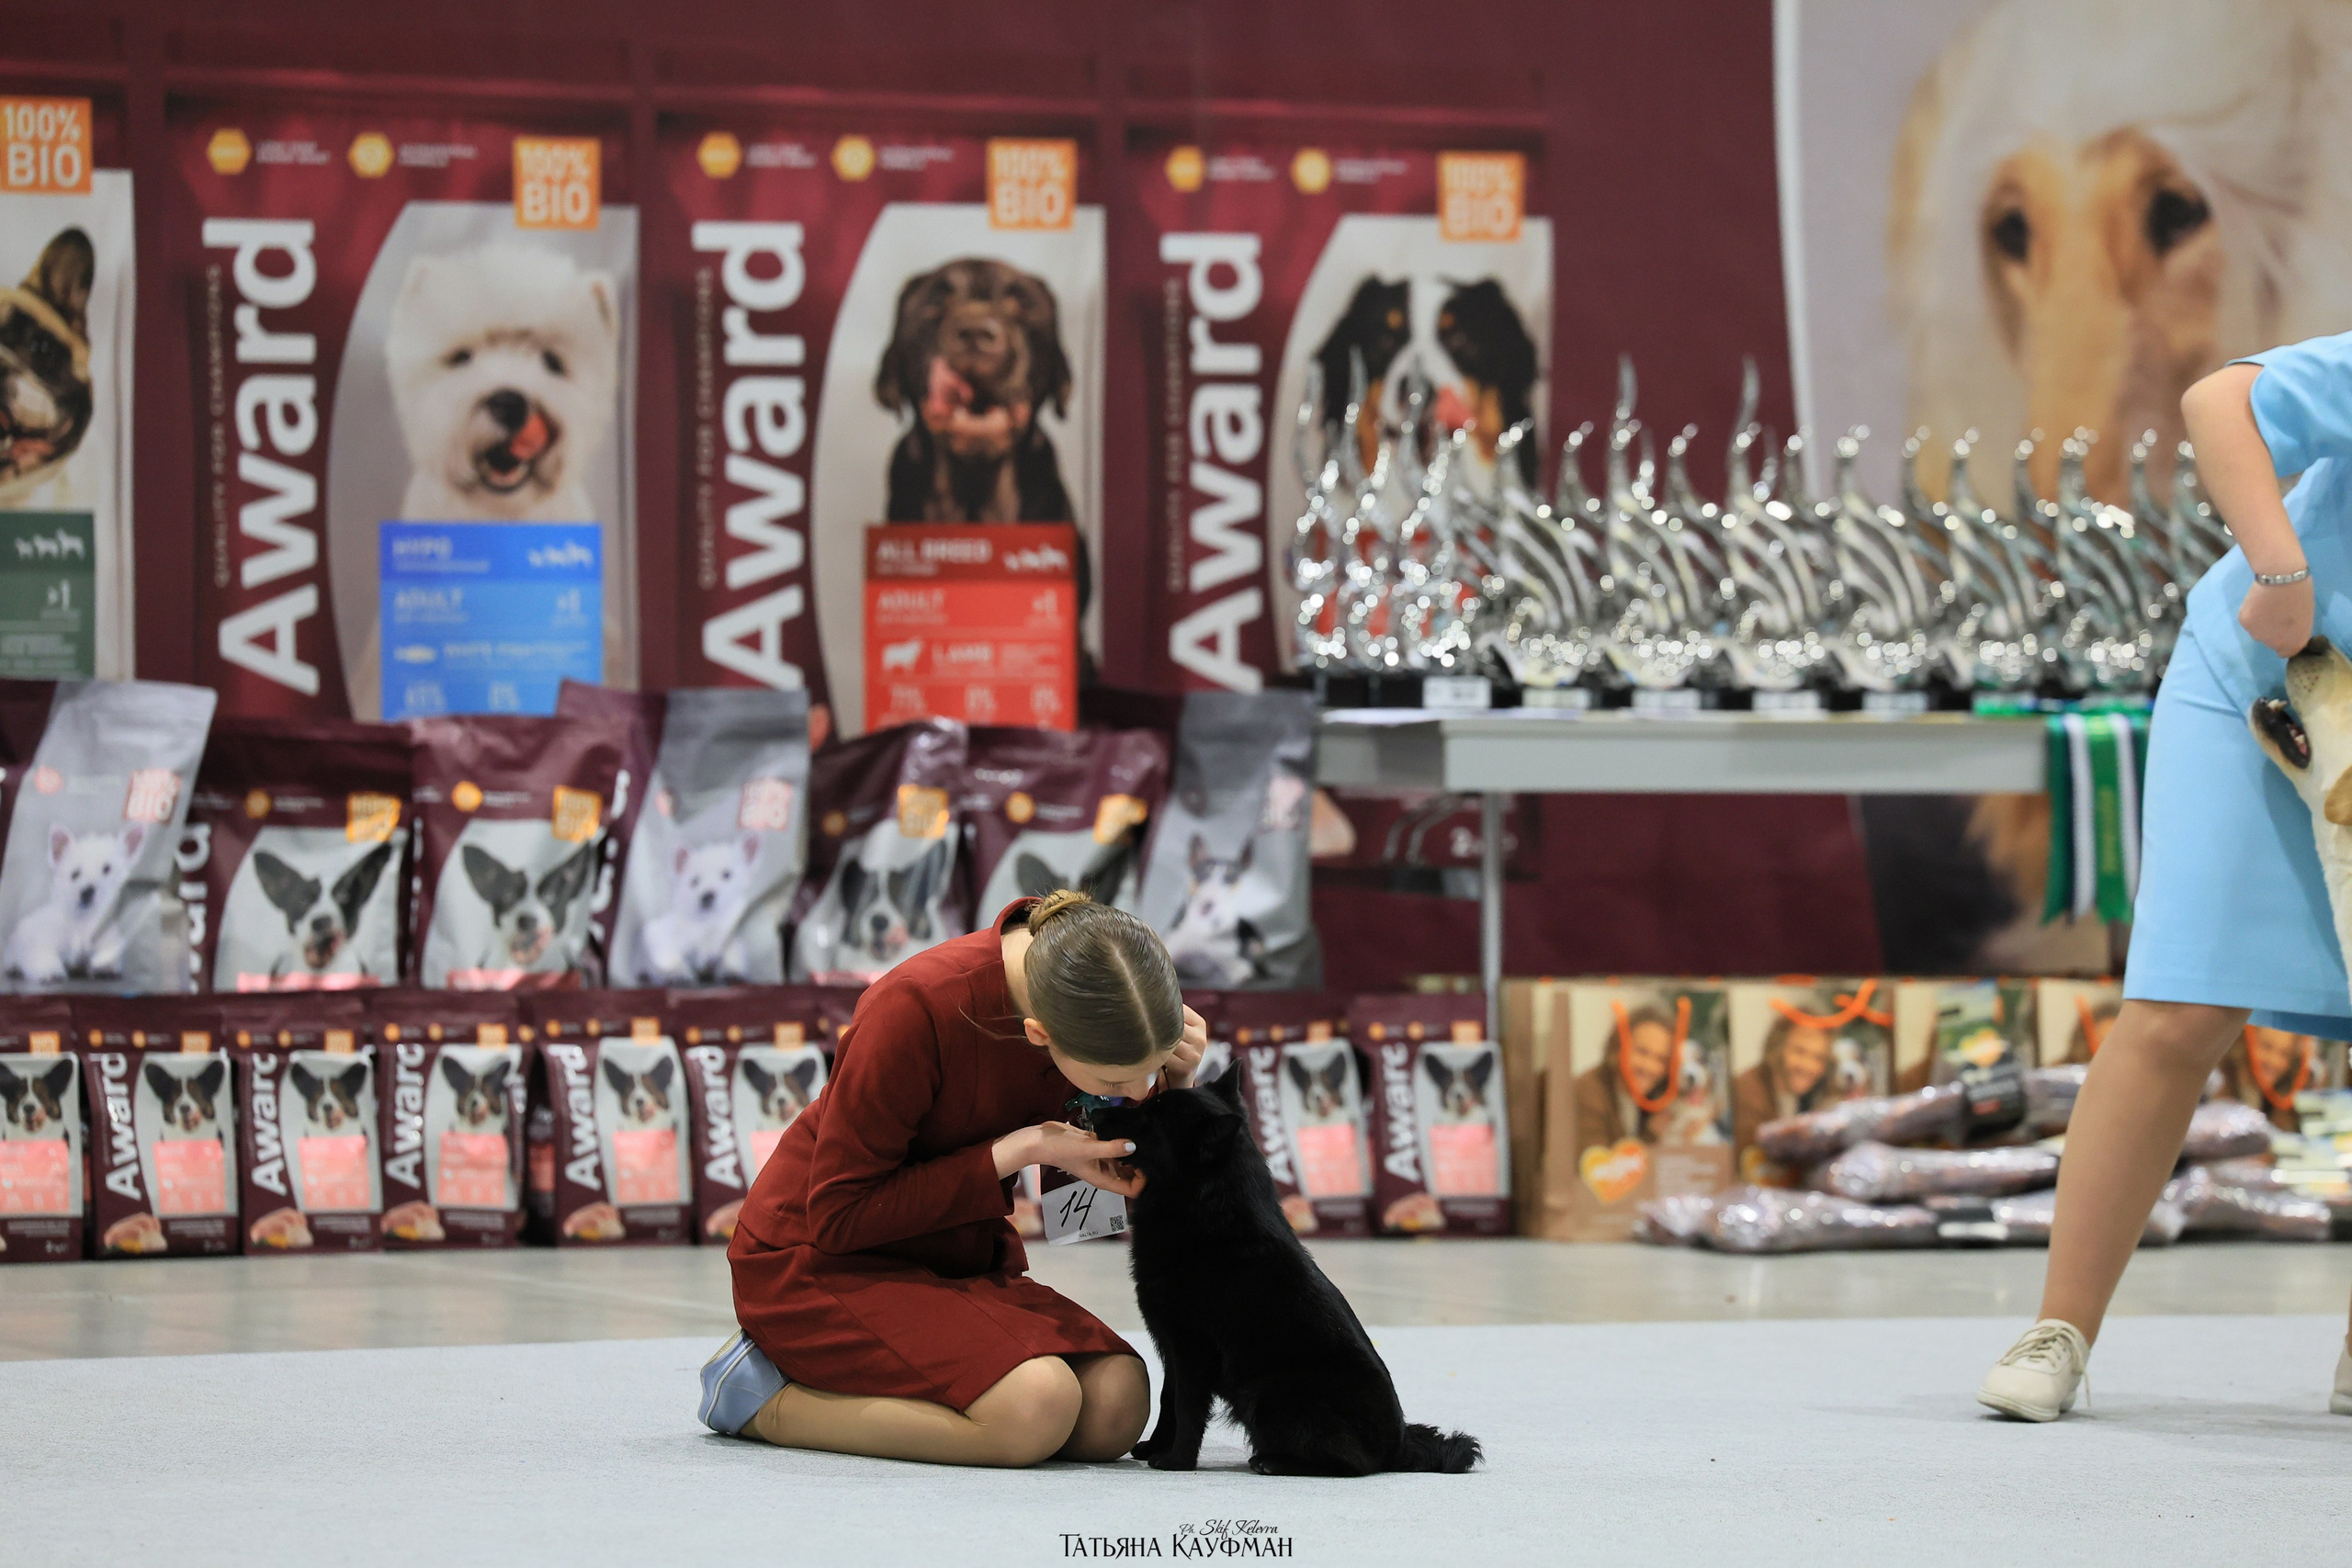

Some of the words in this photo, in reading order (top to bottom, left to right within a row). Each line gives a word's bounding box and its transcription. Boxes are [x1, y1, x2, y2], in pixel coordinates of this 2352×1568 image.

[5, 102, 82, 142] 100%
[8, 143, 81, 186] BIO
[522, 182, 590, 223] BIO
[997, 183, 1068, 225] BIO
[202, 217, 319, 696] Award
[691, 220, 807, 691] Award
[1159, 231, 1263, 694] Award
[547, 1043, 602, 1190] Award
[685, 1045, 742, 1190] Award
[1059, 1188, 1098, 1231] 14
